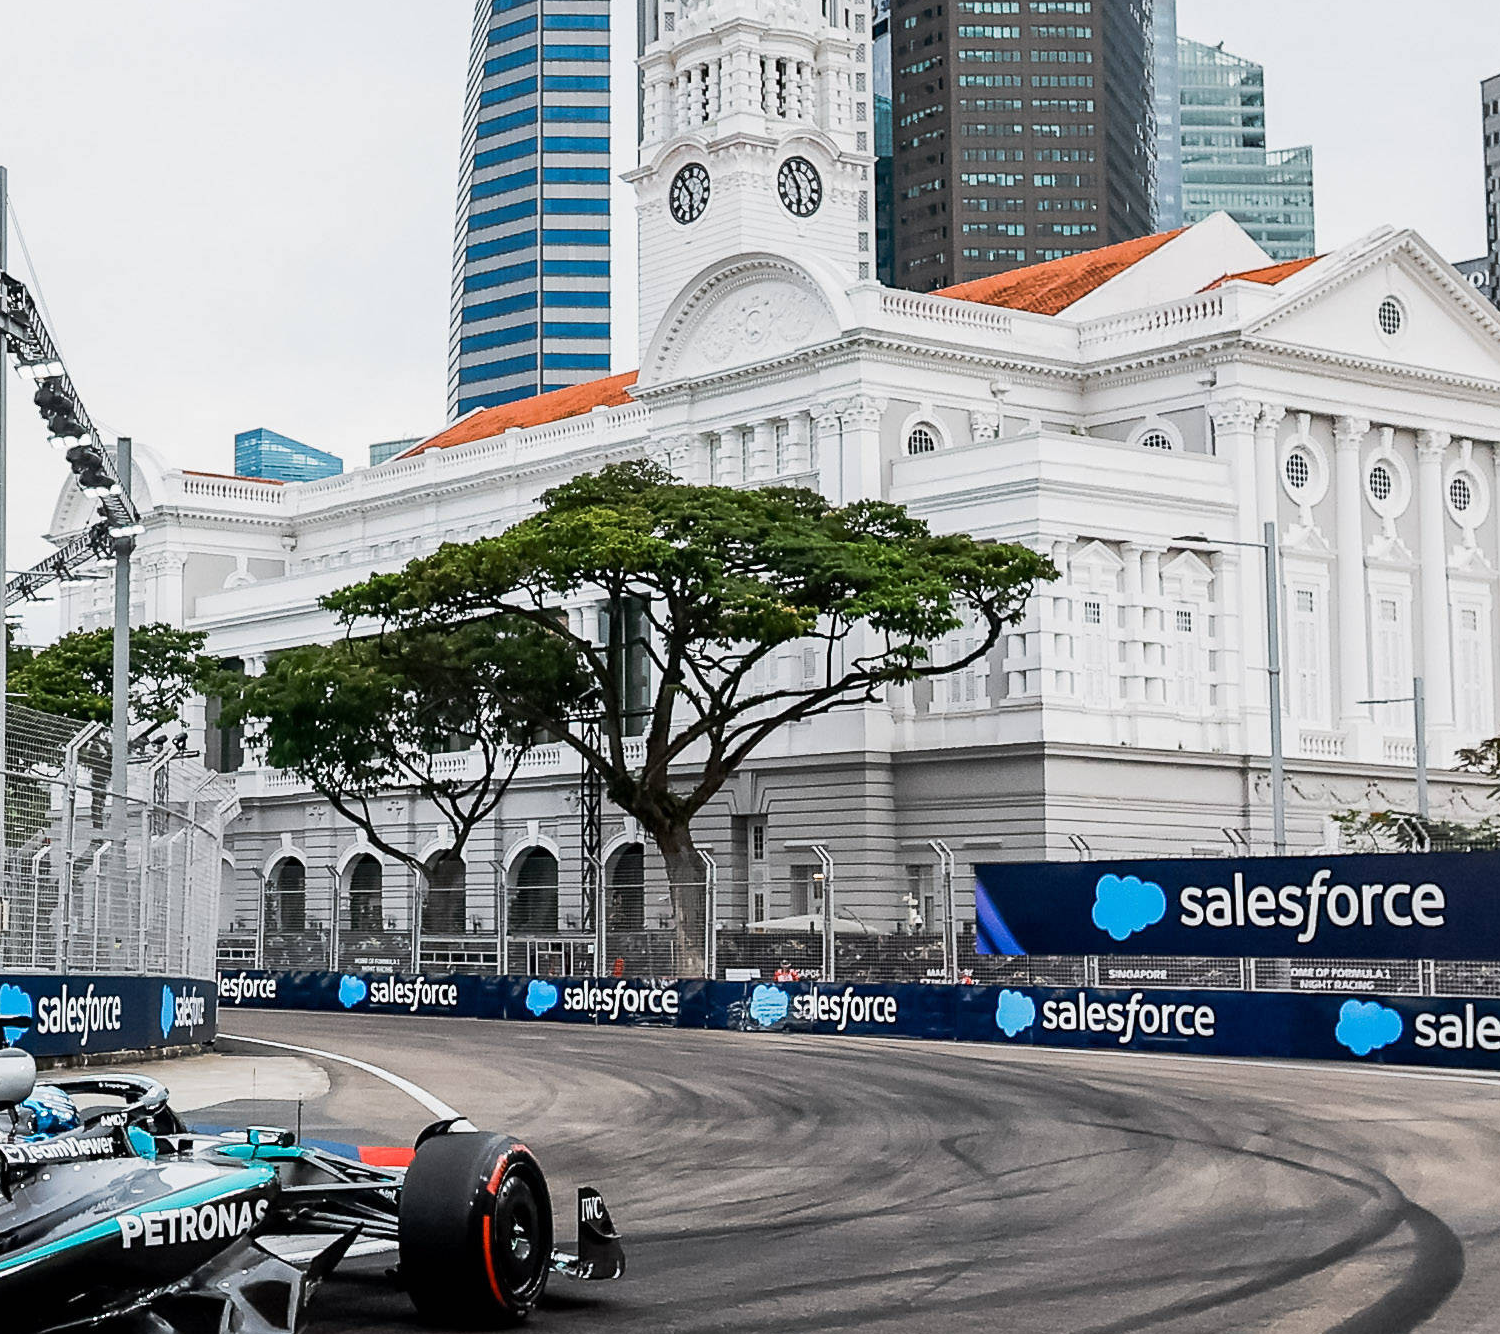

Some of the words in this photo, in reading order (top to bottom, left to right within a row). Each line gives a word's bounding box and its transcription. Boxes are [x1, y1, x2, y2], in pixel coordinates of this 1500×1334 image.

[1180, 869, 1445, 944] salesforce
[217, 971, 277, 1005] lesforce
[1108, 969, 1168, 980] SINGAPORE
[1290, 968, 1315, 977] OME
[1315, 968, 1330, 977] OF
[1331, 968, 1383, 979] FORMULA
[1300, 979, 1333, 989] NIGHT
[1333, 980, 1375, 990] RACING
[174, 986, 205, 1037] salesforce
[370, 975, 458, 1012] salesforce
[564, 978, 679, 1020] salesforce
[792, 985, 897, 1031] salesforce
[37, 983, 121, 1046] salesforce
[1042, 992, 1215, 1044] salesforce
[23, 1136, 114, 1163] TeamViewer
[120, 1198, 270, 1250] PETRONAS
[580, 1195, 604, 1222] IWC
